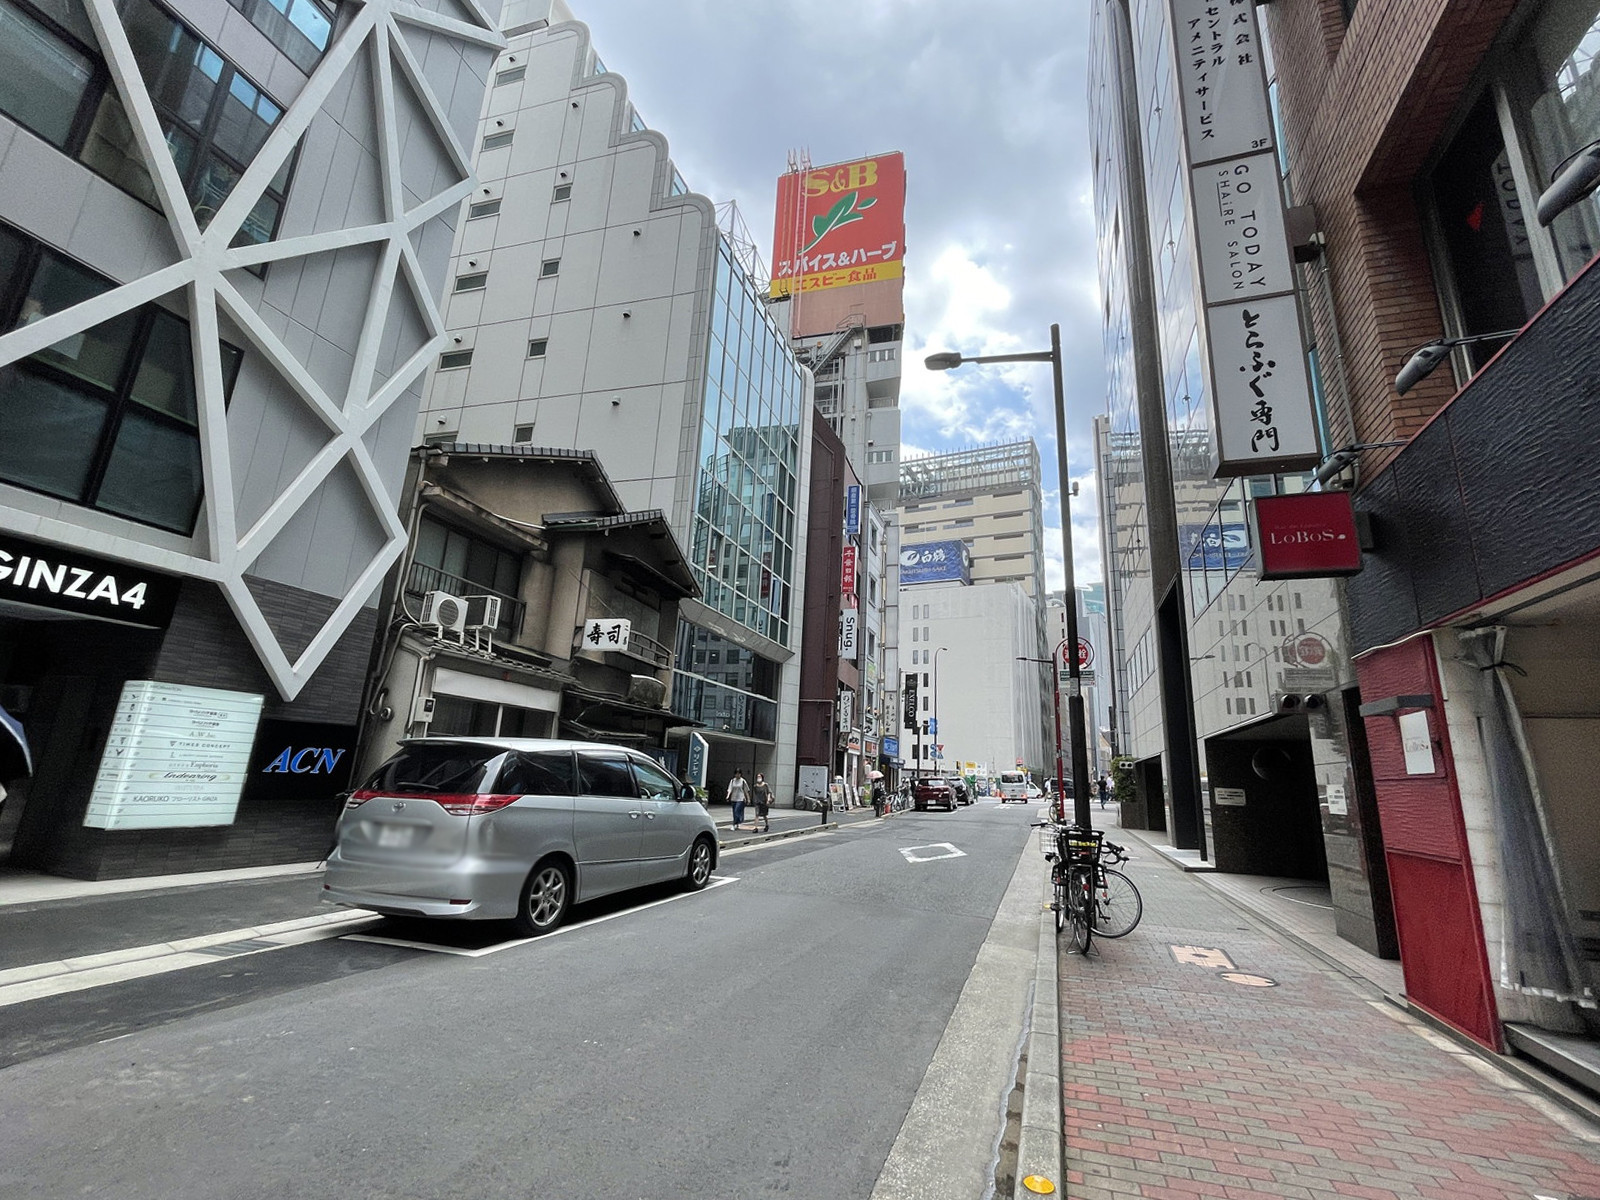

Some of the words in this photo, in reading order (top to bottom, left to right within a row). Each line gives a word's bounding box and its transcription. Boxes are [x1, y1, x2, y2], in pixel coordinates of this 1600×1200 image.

[1205, 0, 1226, 67] セントラル
[1187, 18, 1215, 141] アメニティサービス
[1251, 138, 1268, 148] 3F
[802, 160, 878, 197] S&B
[1234, 164, 1252, 194] GO
[1227, 240, 1245, 290] SALON
[1241, 209, 1266, 287] TODAY
[587, 622, 621, 645] 寿司
[843, 616, 856, 651] Snug.
[262, 745, 346, 774] ACN
